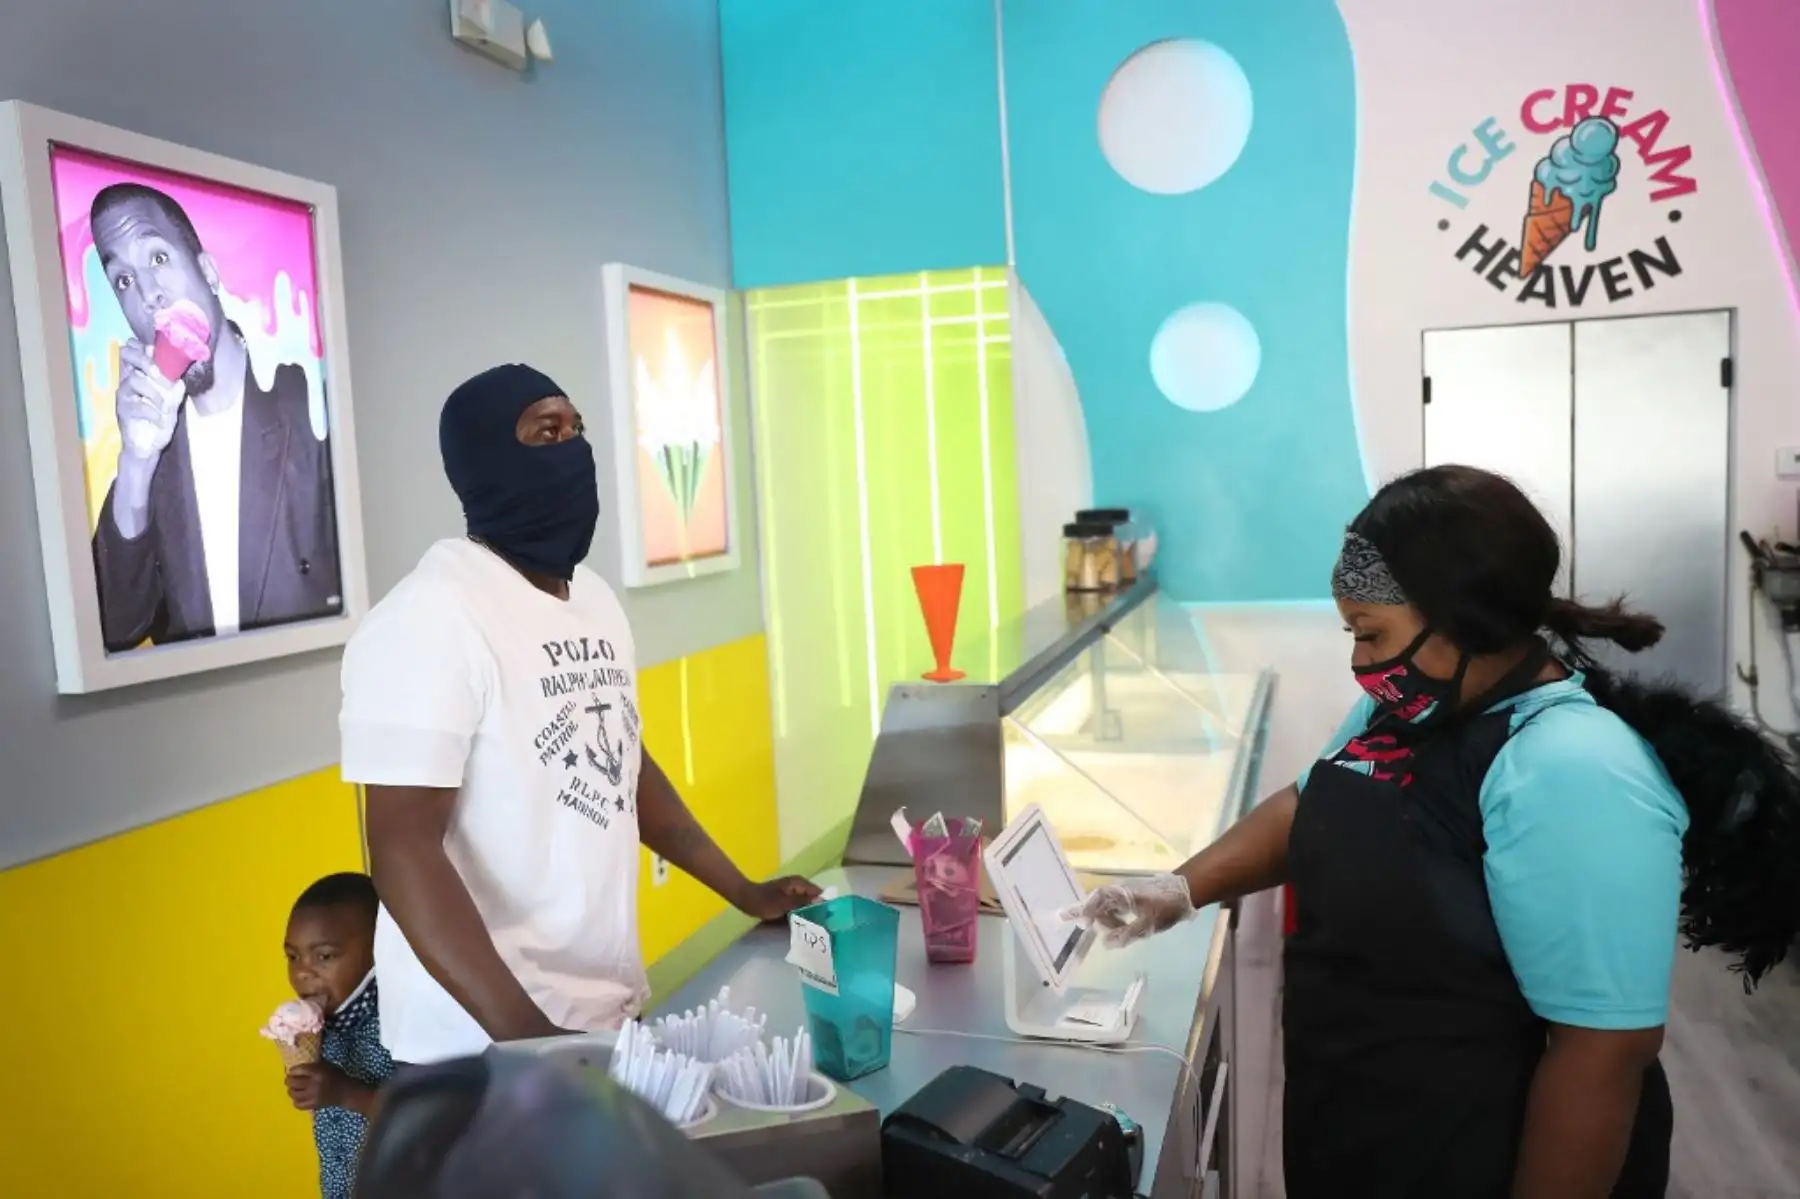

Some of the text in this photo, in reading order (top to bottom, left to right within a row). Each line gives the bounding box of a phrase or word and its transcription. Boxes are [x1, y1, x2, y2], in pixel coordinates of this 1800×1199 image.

[1428, 83, 1697, 210] ICE CREAM
[1454, 223, 1683, 309] HEAVEN
[542, 637, 615, 667] POLO
